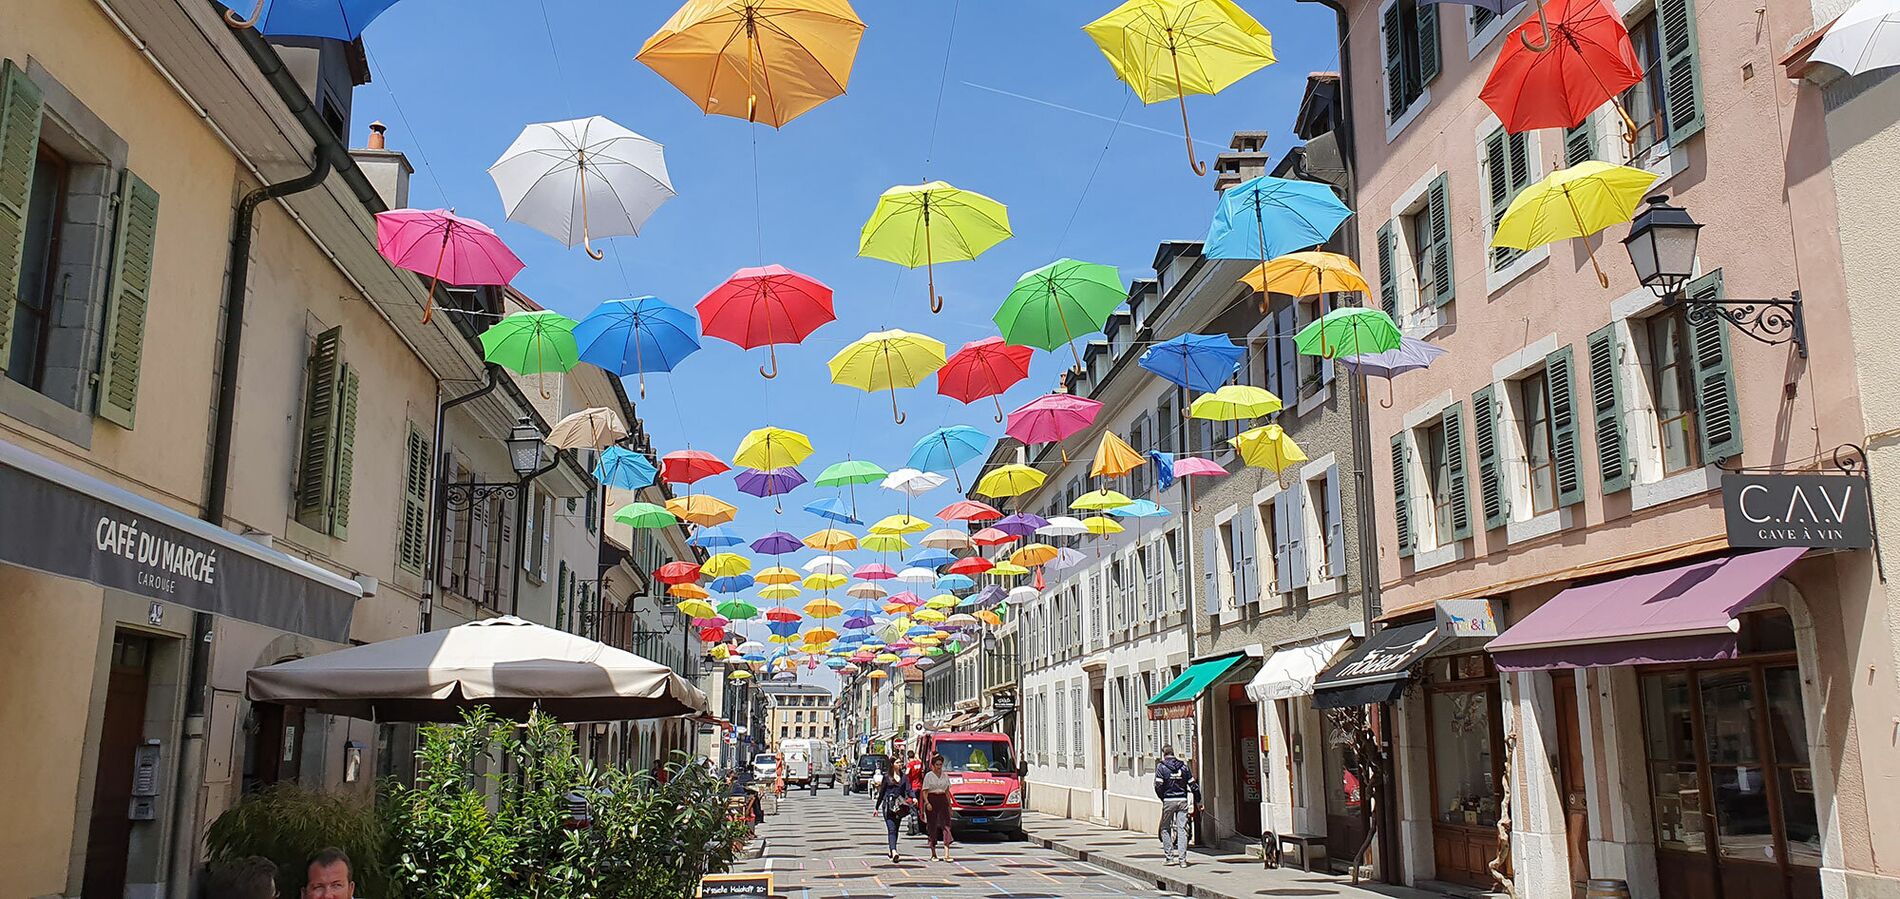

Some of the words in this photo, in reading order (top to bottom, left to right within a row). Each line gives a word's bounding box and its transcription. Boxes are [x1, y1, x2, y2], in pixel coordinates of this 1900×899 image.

[1739, 484, 1852, 523] C.A.V
[1758, 529, 1797, 540] CAVE
[1800, 526, 1812, 540] À
[1817, 529, 1843, 540] VIN
[96, 516, 138, 560] CAFÉ
[137, 531, 161, 567] DU
[162, 540, 216, 584] MARCHÉ
[138, 571, 176, 594] CAROUGE
